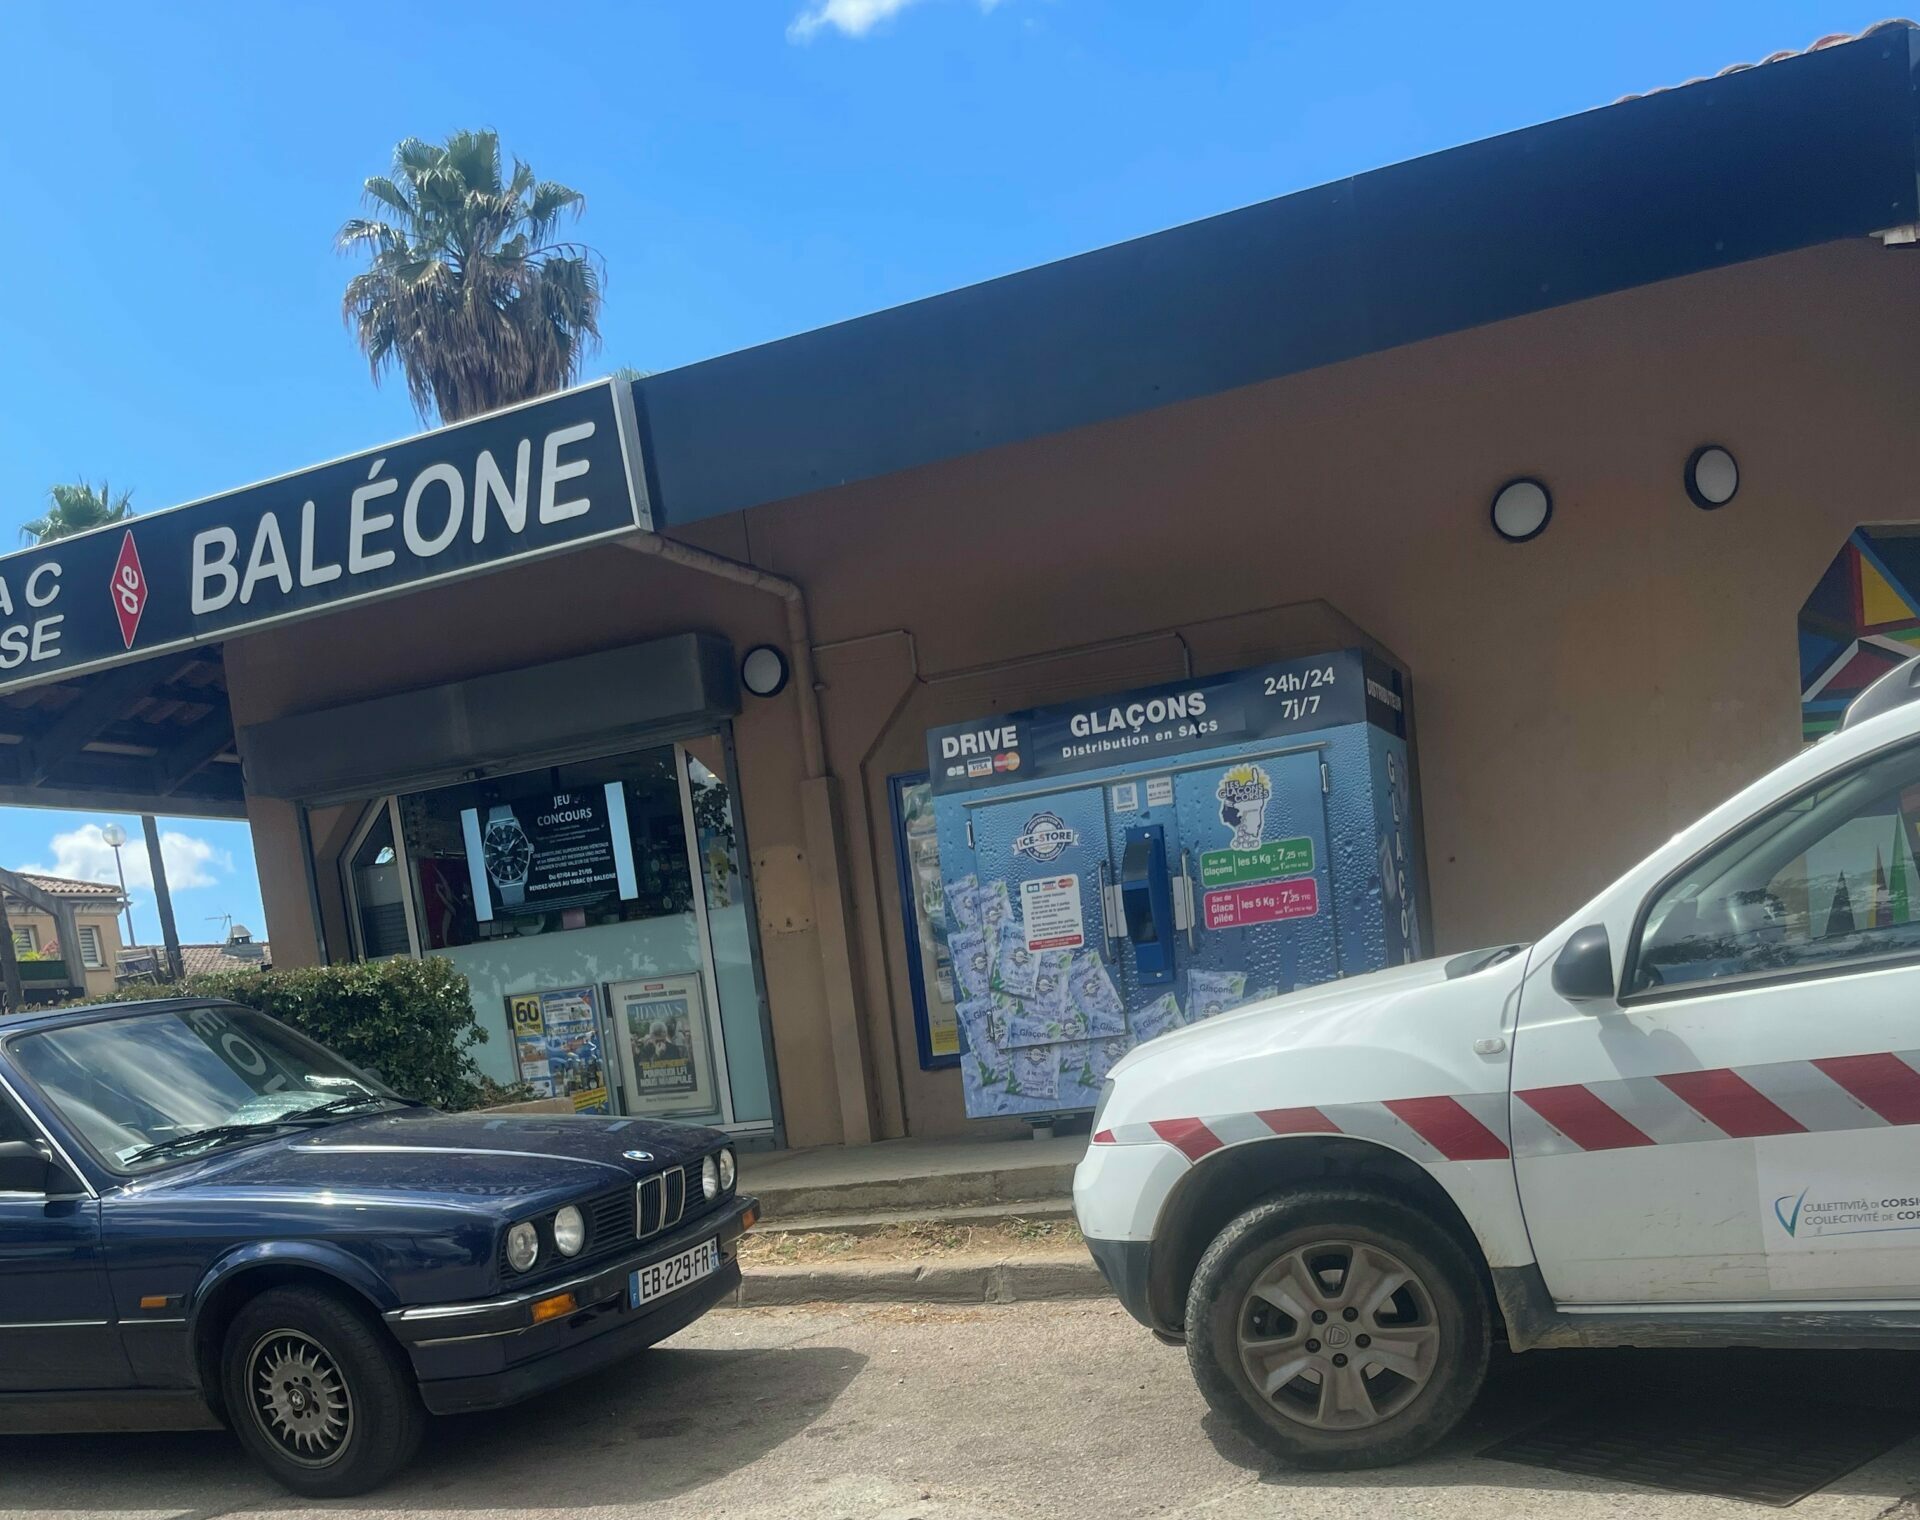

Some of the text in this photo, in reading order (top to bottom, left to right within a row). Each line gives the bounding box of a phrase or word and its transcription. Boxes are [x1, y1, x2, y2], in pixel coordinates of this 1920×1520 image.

[117, 421, 595, 616] de BALÉONE
[1263, 667, 1335, 695] 24h/24
[1071, 692, 1206, 738] GLAÇONS
[1280, 695, 1320, 720] 7j/7
[941, 725, 1019, 759] DRIVE
[1062, 720, 1218, 759] Distribution en SACS
[553, 794, 570, 809] JEU
[537, 808, 593, 826] CONCOURS
[1019, 831, 1072, 848] ICE-STORE
[1238, 857, 1251, 867] les
[1252, 855, 1258, 865] 5
[1259, 853, 1271, 865] Kg
[1203, 865, 1233, 877] Glaçons
[1211, 903, 1234, 914] Glace
[1241, 899, 1254, 909] les
[1255, 898, 1262, 908] 5
[1263, 896, 1275, 908] Kg
[1213, 914, 1234, 925] pilée
[961, 938, 985, 950] Glaçon
[515, 1000, 540, 1023] 60
[1100, 1022, 1126, 1035] Glaçon
[1870, 1201, 1880, 1209] DI
[1881, 1197, 1920, 1208] CORSI
[1804, 1212, 1879, 1226] COLLECTIVITÉ
[1882, 1213, 1894, 1222] DE
[642, 1245, 710, 1299] EB-229-FR
